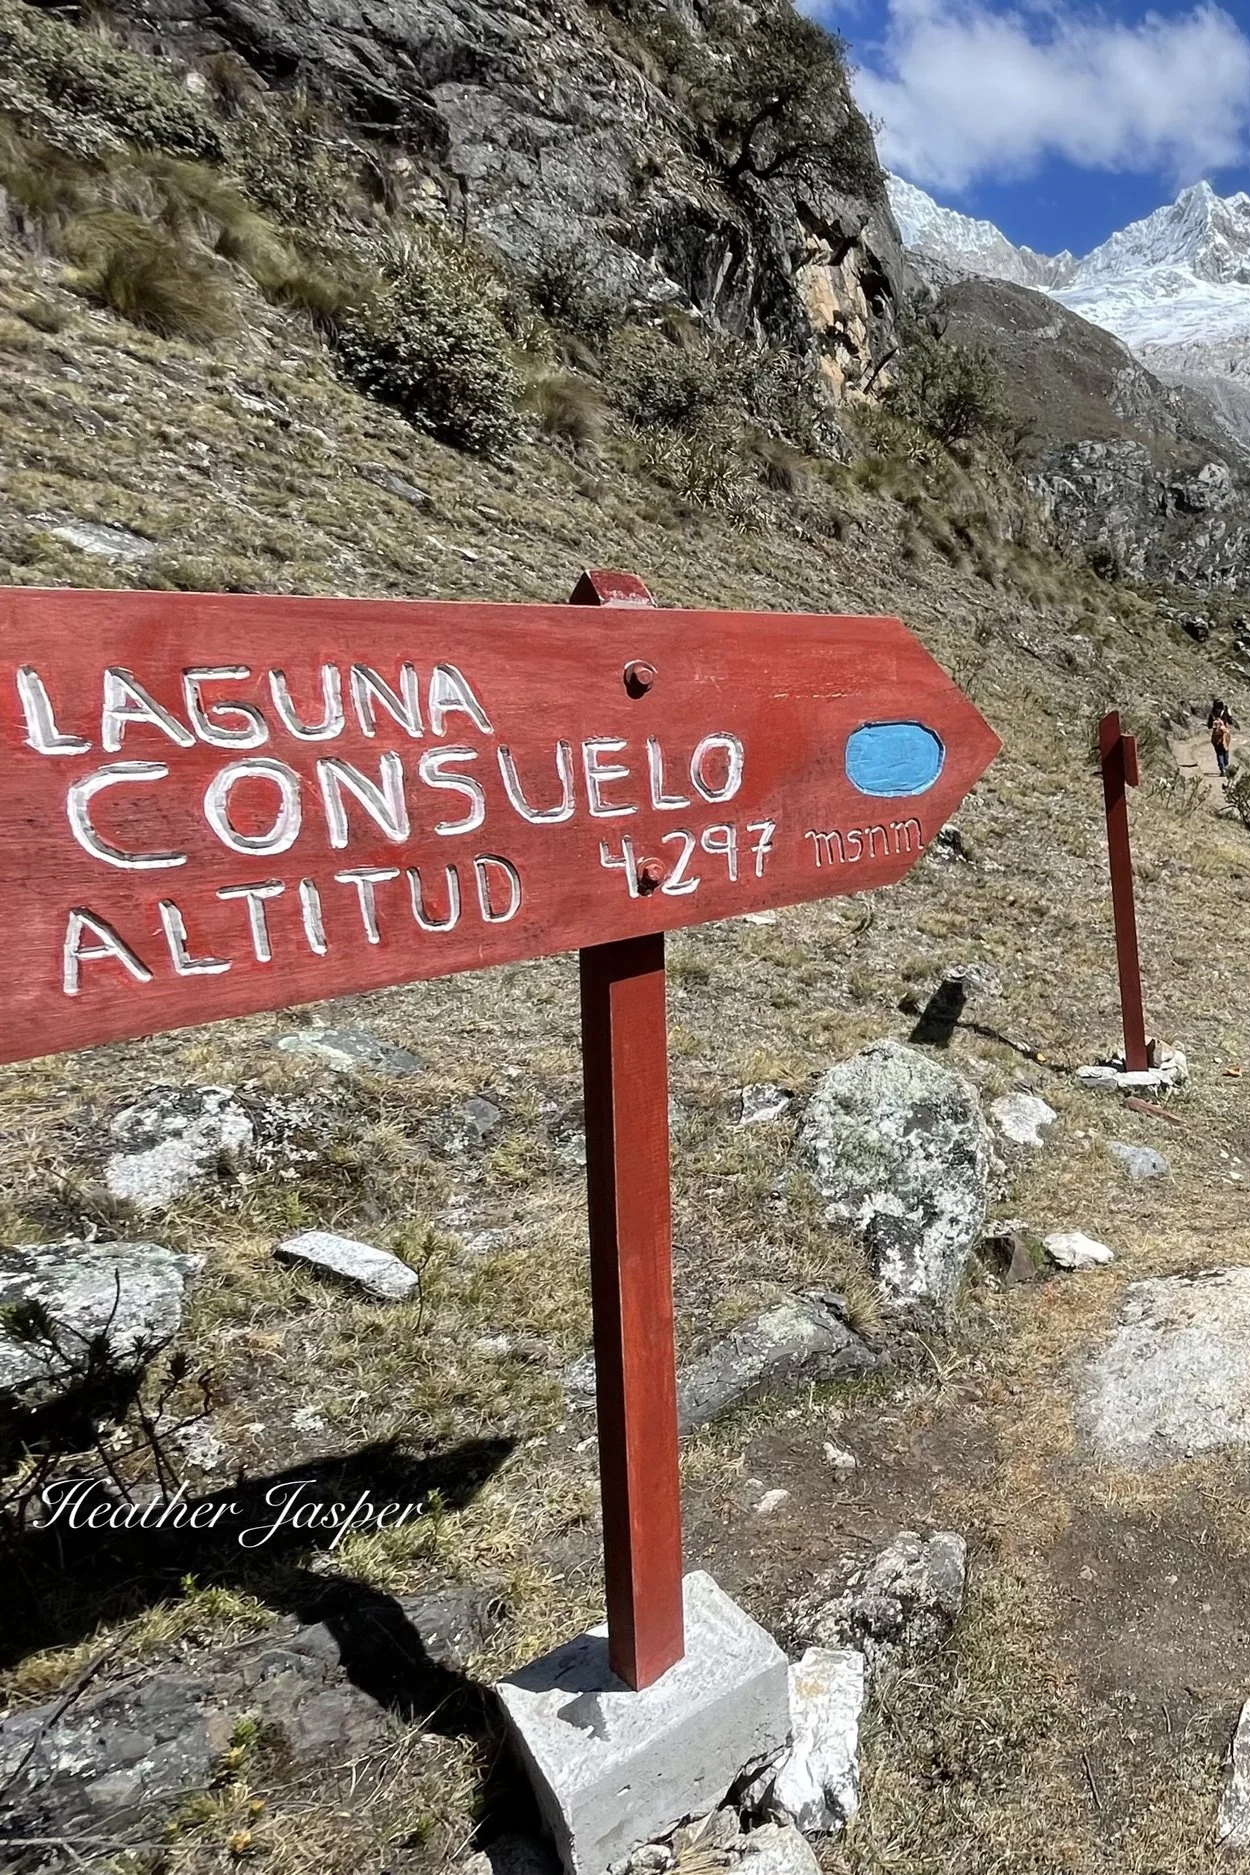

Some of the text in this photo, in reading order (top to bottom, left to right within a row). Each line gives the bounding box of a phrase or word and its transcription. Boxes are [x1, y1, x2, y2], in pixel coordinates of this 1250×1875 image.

[17, 661, 494, 755] LAGUNA
[67, 731, 746, 869] CONSUELO
[63, 853, 523, 996] ALTITUD
[803, 816, 925, 868] msnm
